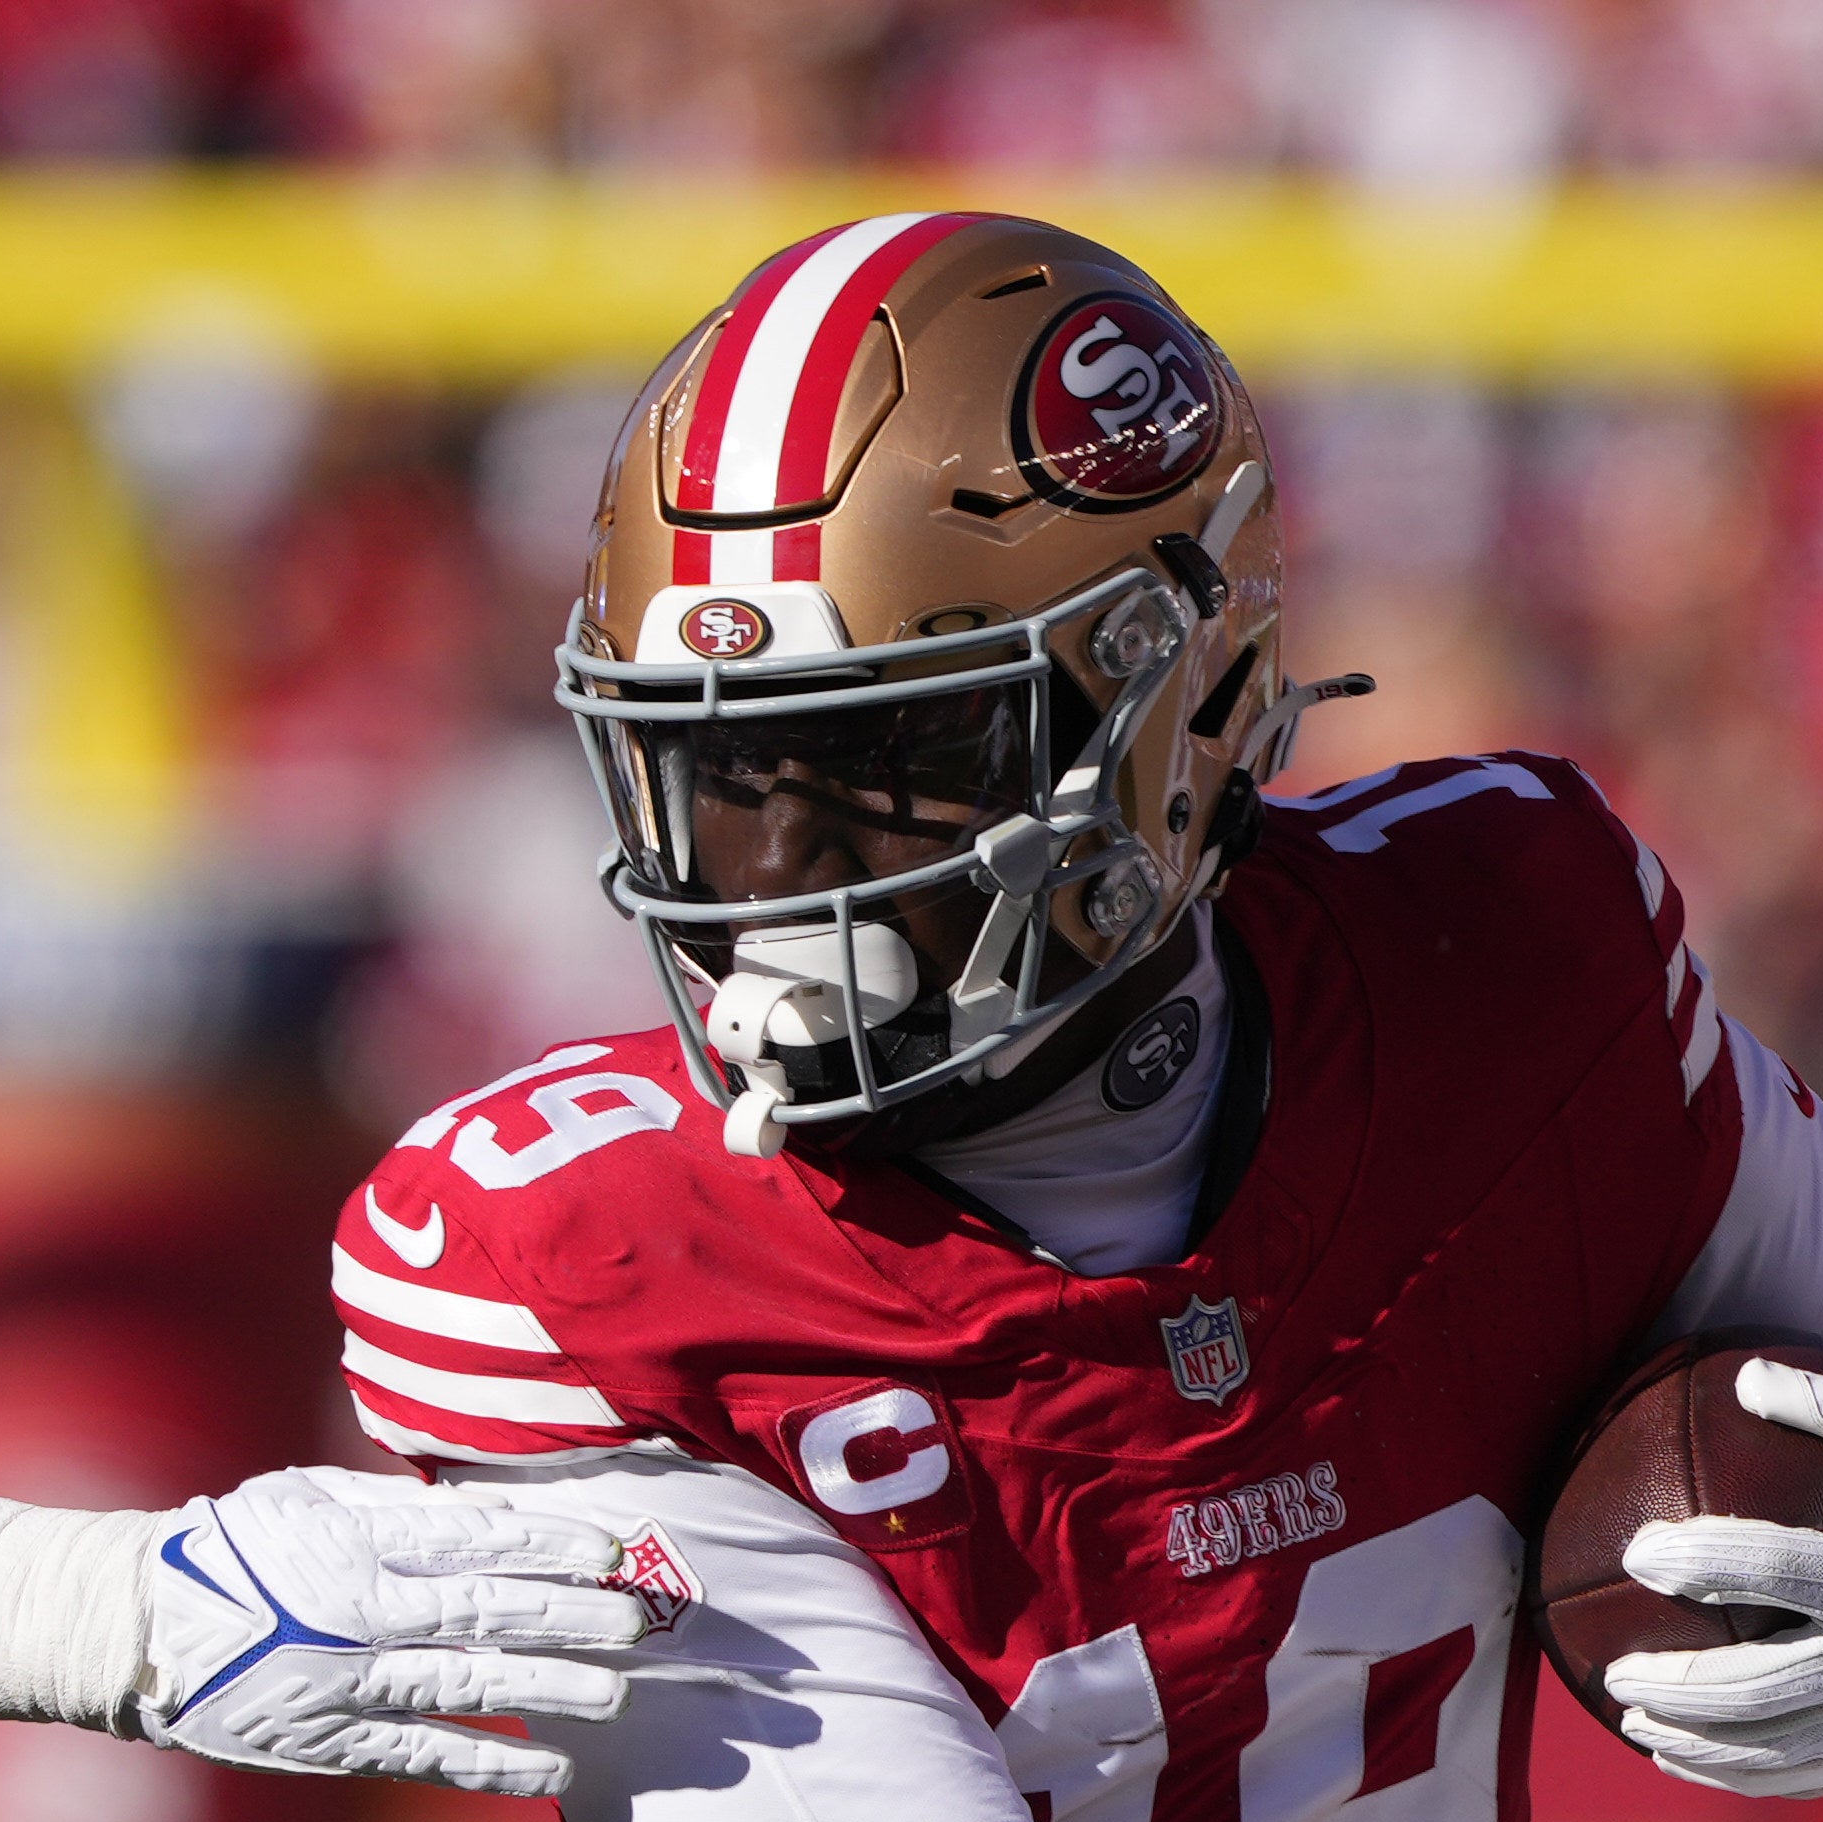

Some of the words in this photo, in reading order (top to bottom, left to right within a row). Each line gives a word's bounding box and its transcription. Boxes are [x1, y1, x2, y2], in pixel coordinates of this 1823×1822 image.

[393, 1043, 685, 1192] 19
[1180, 1340, 1237, 1386] NFL
[798, 1387, 951, 1516] C
[1166, 1459, 1347, 1579] 49ERS
